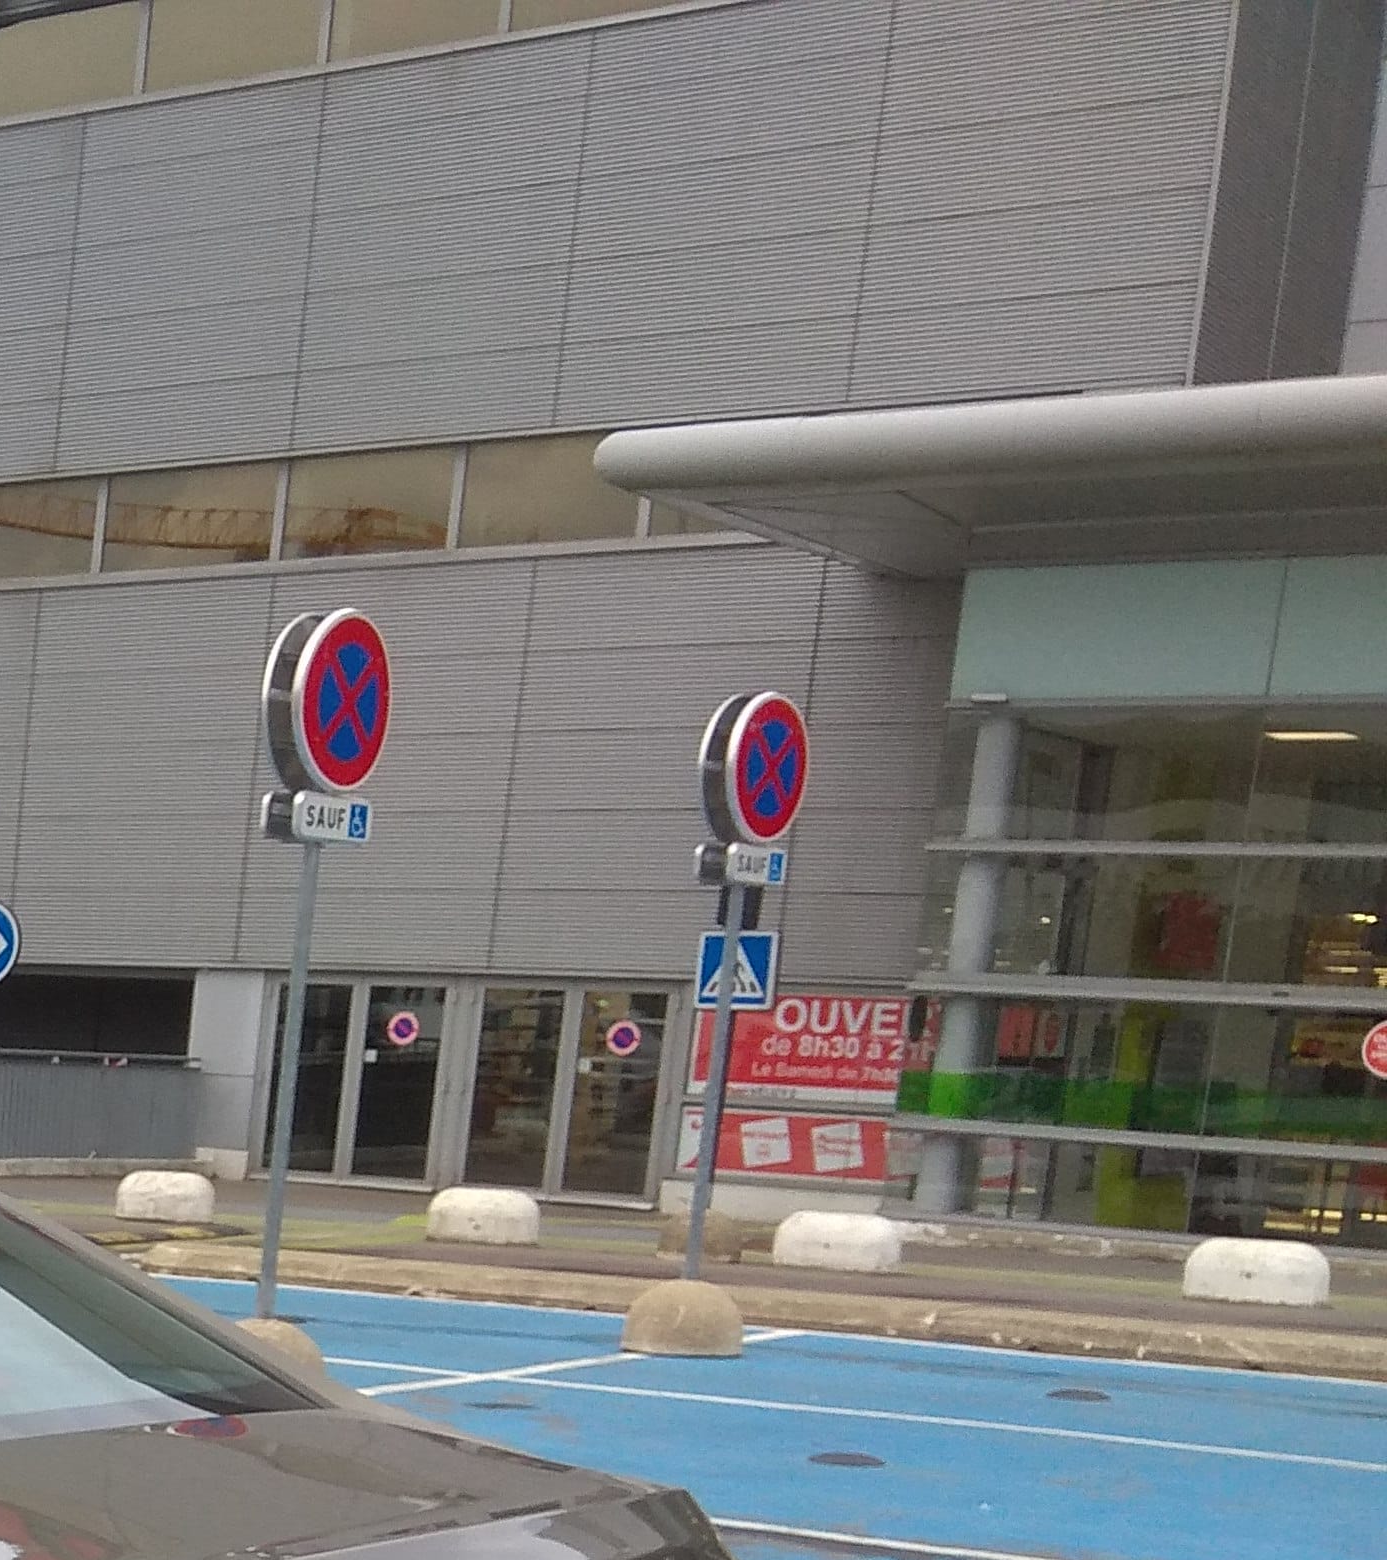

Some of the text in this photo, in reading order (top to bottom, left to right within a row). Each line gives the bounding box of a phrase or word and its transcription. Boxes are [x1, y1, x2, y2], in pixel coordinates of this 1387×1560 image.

[306, 805, 346, 830] SAUF
[761, 1033, 792, 1056] de
[798, 1034, 859, 1058] 8h30
